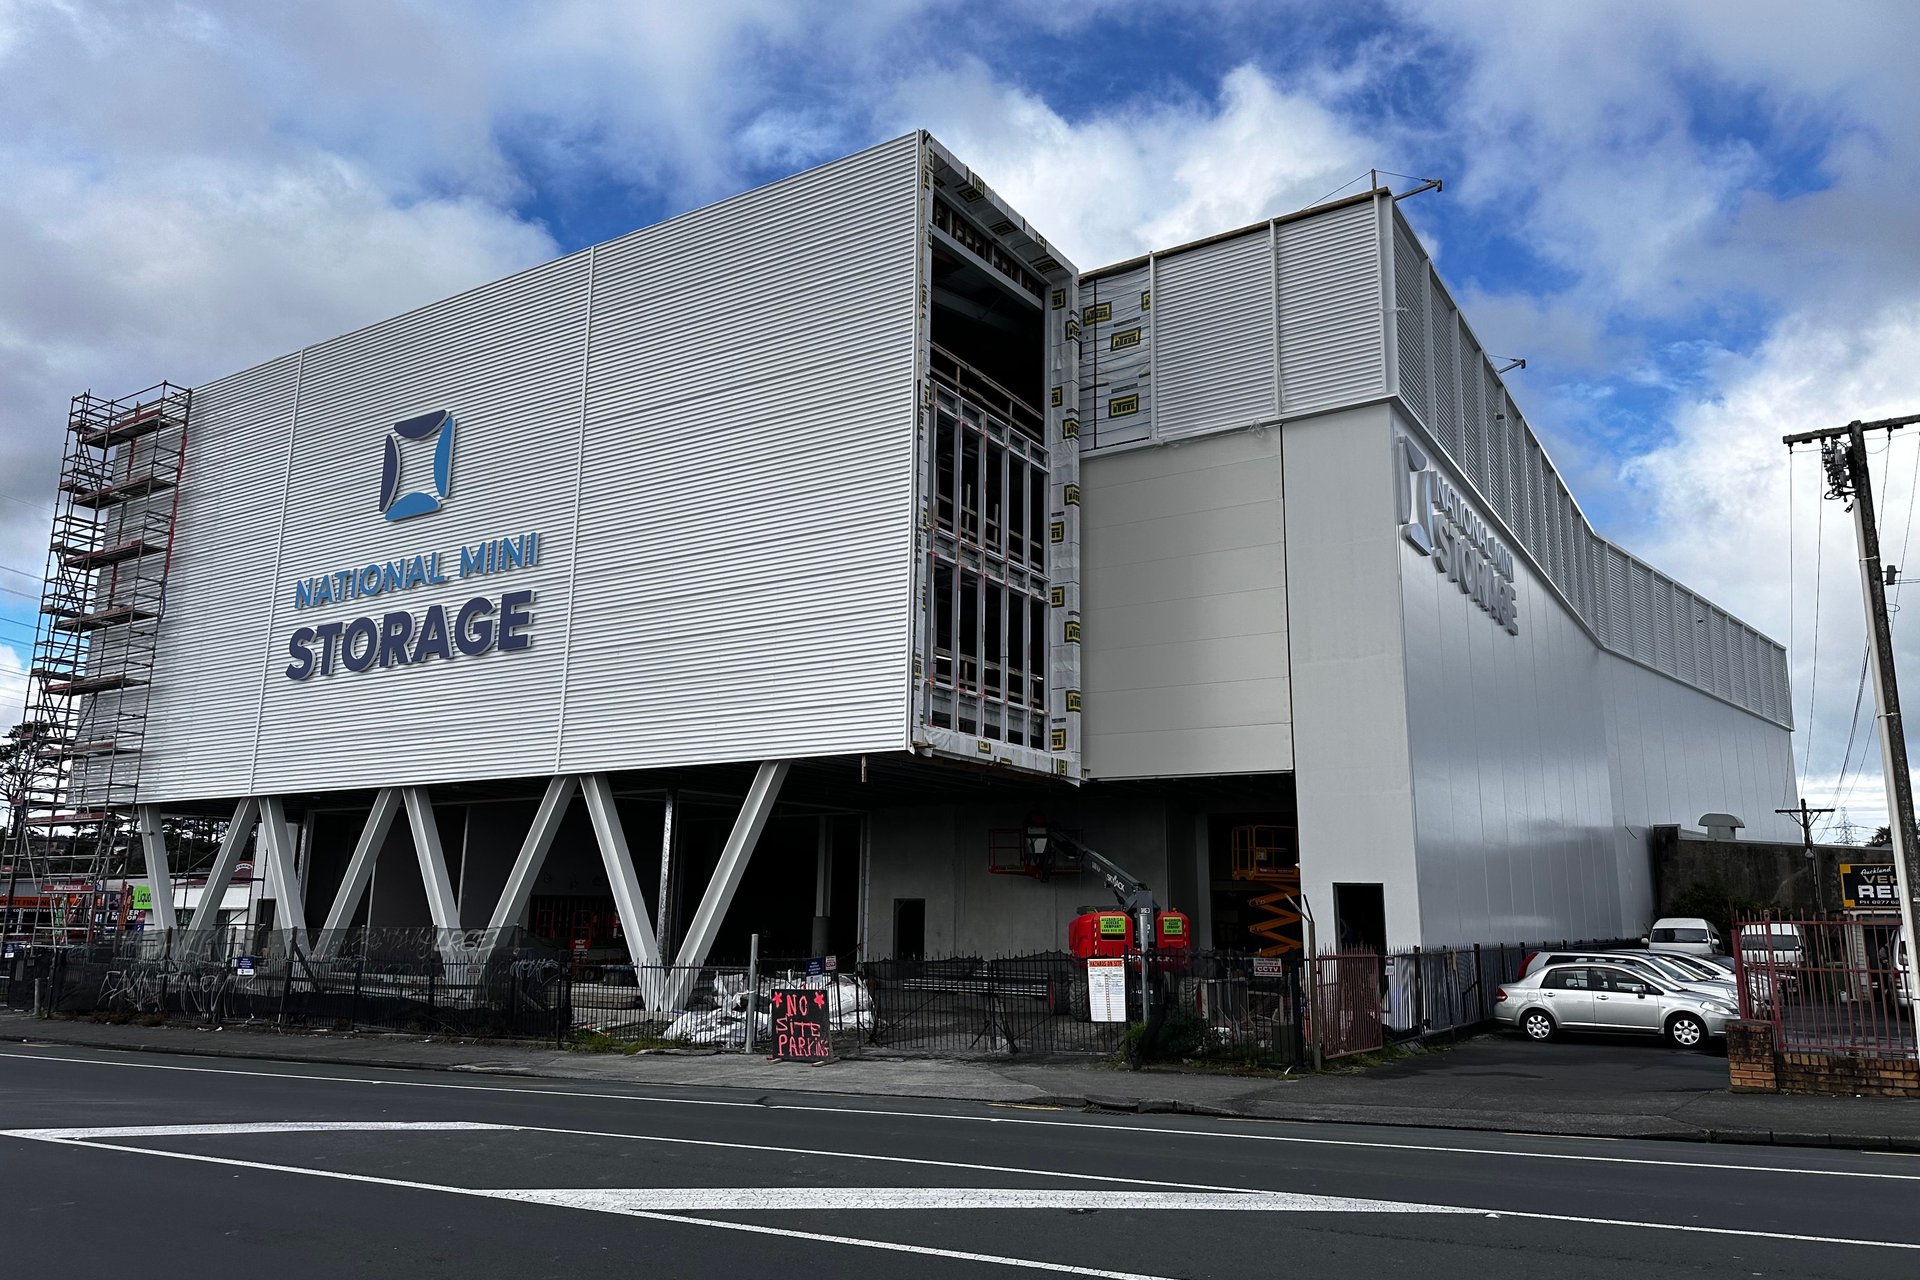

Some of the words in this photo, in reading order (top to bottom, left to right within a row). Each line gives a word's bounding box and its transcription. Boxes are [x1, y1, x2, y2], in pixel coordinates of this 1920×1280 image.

[1431, 471, 1496, 564] NATIONAL
[294, 552, 448, 609] NATIONAL
[459, 532, 540, 578] MINI
[1432, 513, 1519, 636] STORAGE
[285, 590, 537, 681] STORAGE
[1860, 866, 1891, 875] Auckland
[786, 994, 808, 1016] NO
